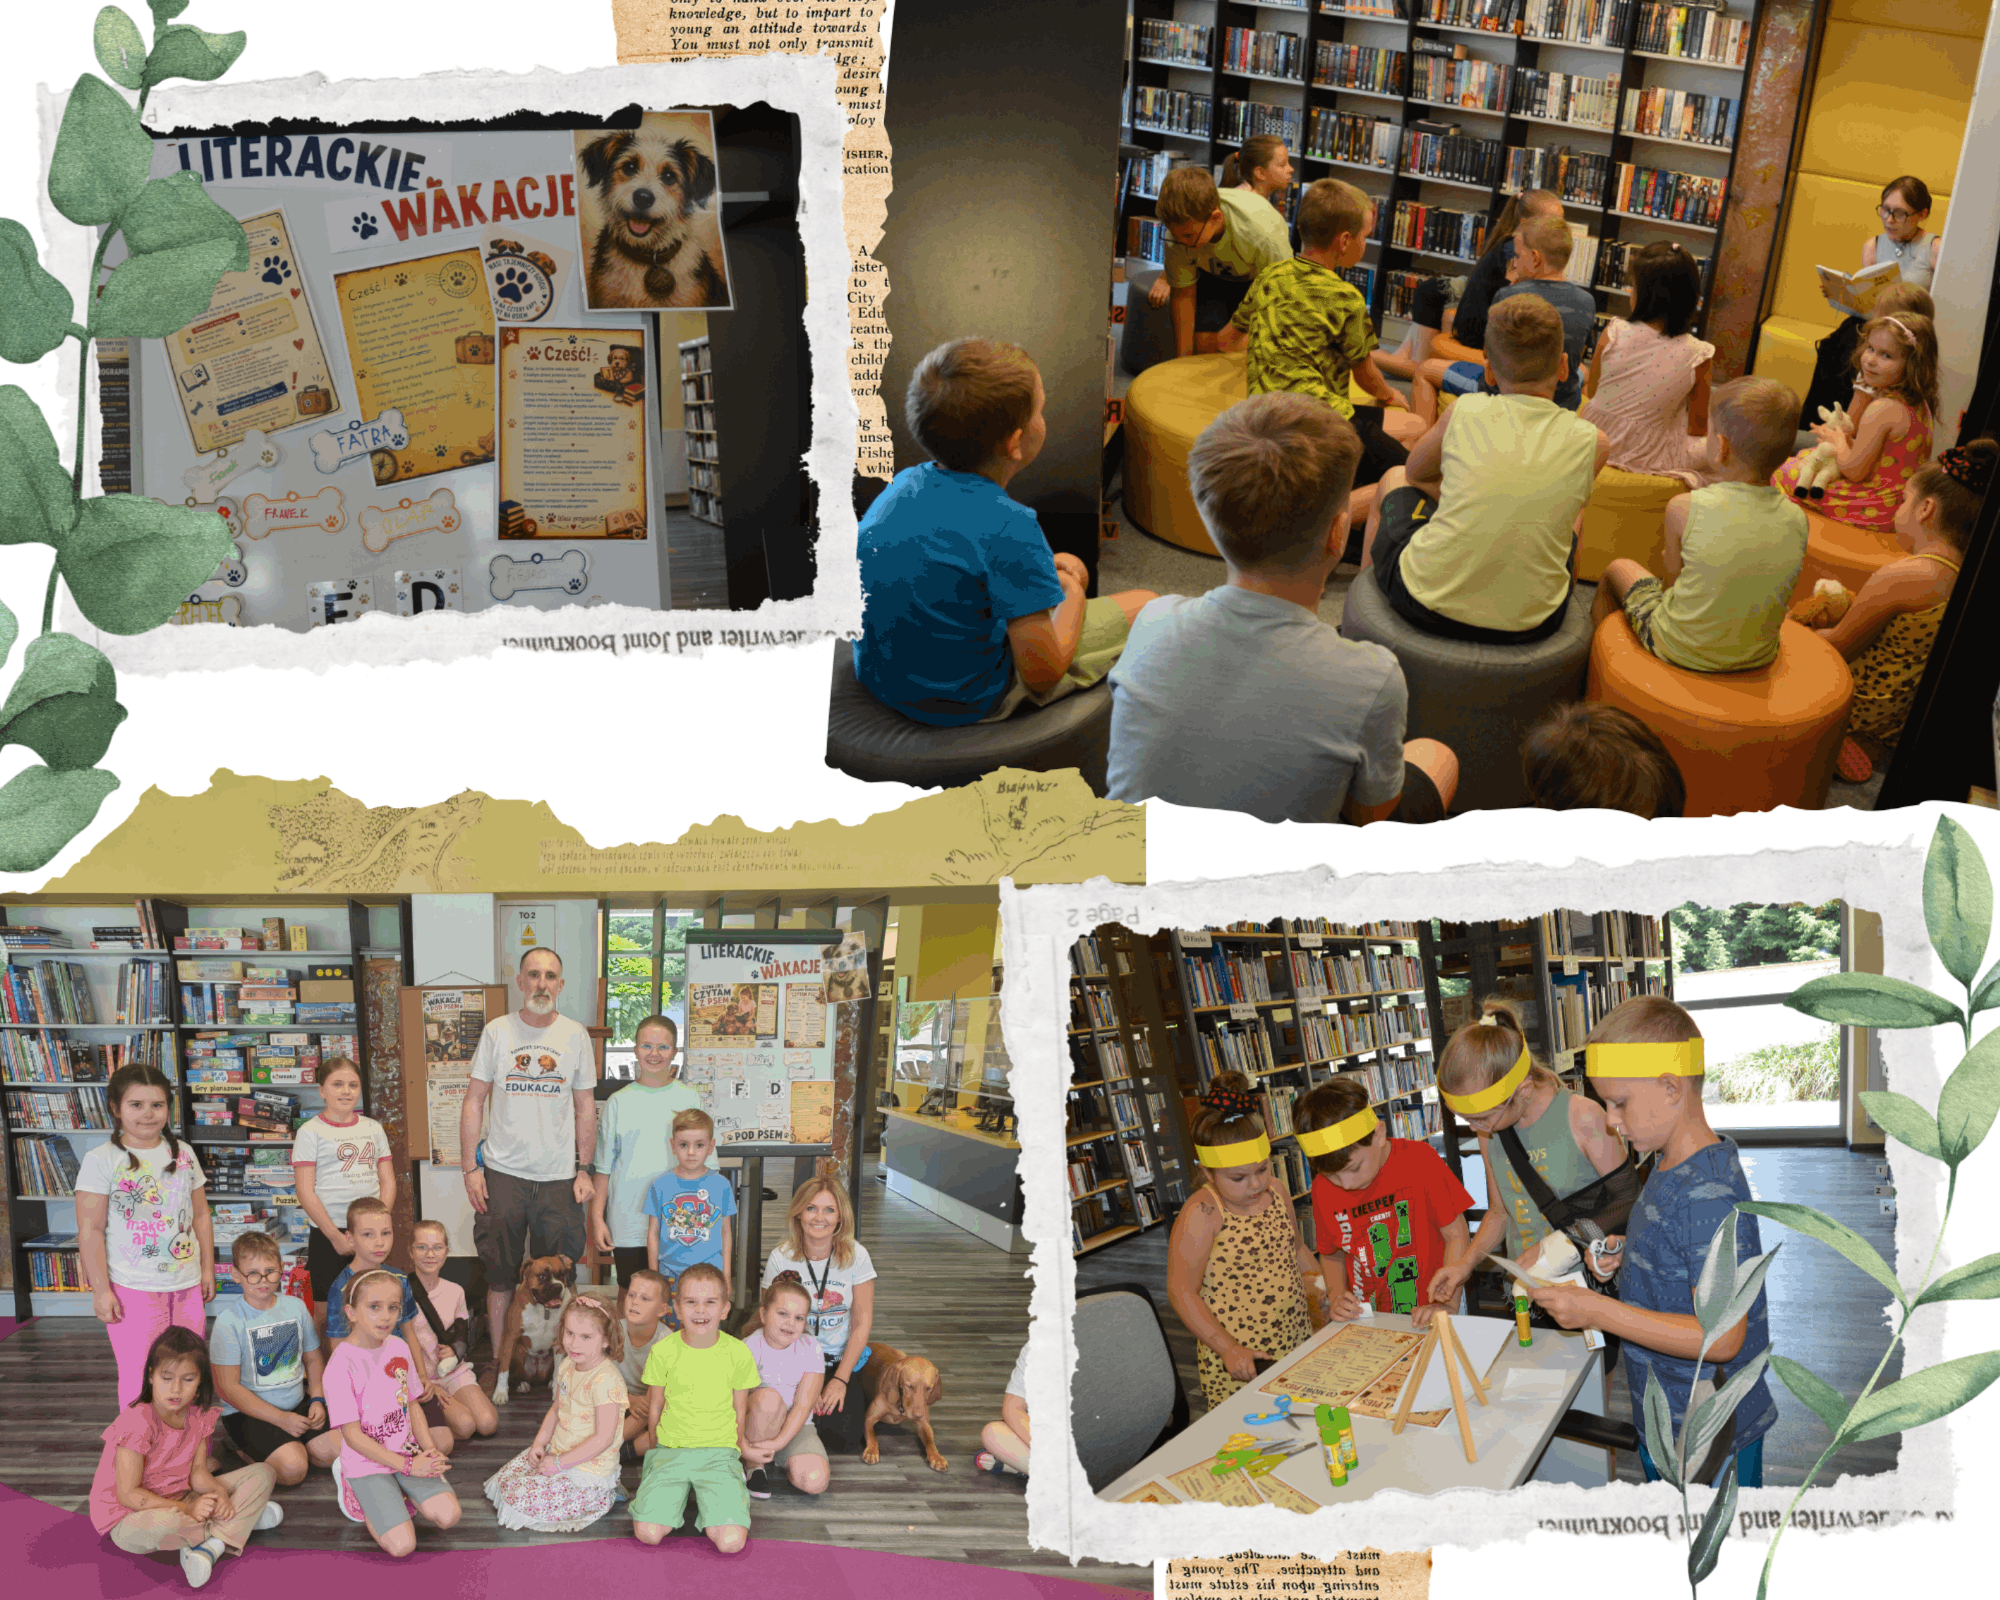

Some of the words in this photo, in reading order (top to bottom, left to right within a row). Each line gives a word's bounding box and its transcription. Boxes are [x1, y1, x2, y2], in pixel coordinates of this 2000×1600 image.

[669, 7, 747, 21] knowledge,
[756, 7, 778, 19] but
[786, 8, 799, 19] to
[806, 7, 851, 21] impart
[860, 8, 873, 19] to
[670, 24, 712, 38] young
[750, 22, 802, 34] attitude
[813, 22, 867, 33] towards
[670, 38, 698, 50] You
[707, 40, 740, 50] must
[748, 39, 771, 50] not
[779, 38, 808, 52] only
[816, 38, 873, 49] transmit
[835, 85, 869, 97] oung
[848, 100, 882, 110] must
[842, 147, 888, 160] ISHER,
[853, 277, 867, 288] to
[847, 291, 876, 307] City
[853, 338, 864, 349] is
[544, 346, 591, 362] Cześć!
[337, 425, 391, 454] FATRA
[624, 630, 670, 653] Joint
[676, 629, 712, 650] and
[1067, 908, 1079, 927] 2
[1086, 902, 1139, 924] Page
[700, 944, 775, 964] LITERACKIE
[760, 960, 821, 980] WAKACJE
[427, 997, 462, 1007] WAKACJE
[693, 989, 731, 1001] CZYTAM
[707, 997, 729, 1006] PSEM
[506, 1083, 561, 1094] EDUKACJA
[735, 1083, 745, 1096] F
[771, 1083, 781, 1095] D
[735, 1131, 755, 1141] POD
[758, 1130, 783, 1140] PSEM
[336, 1141, 376, 1172] 94
[126, 1219, 167, 1233] make
[132, 1232, 159, 1247] art
[257, 1327, 274, 1339] NIKE
[1740, 1510, 1781, 1535] and
